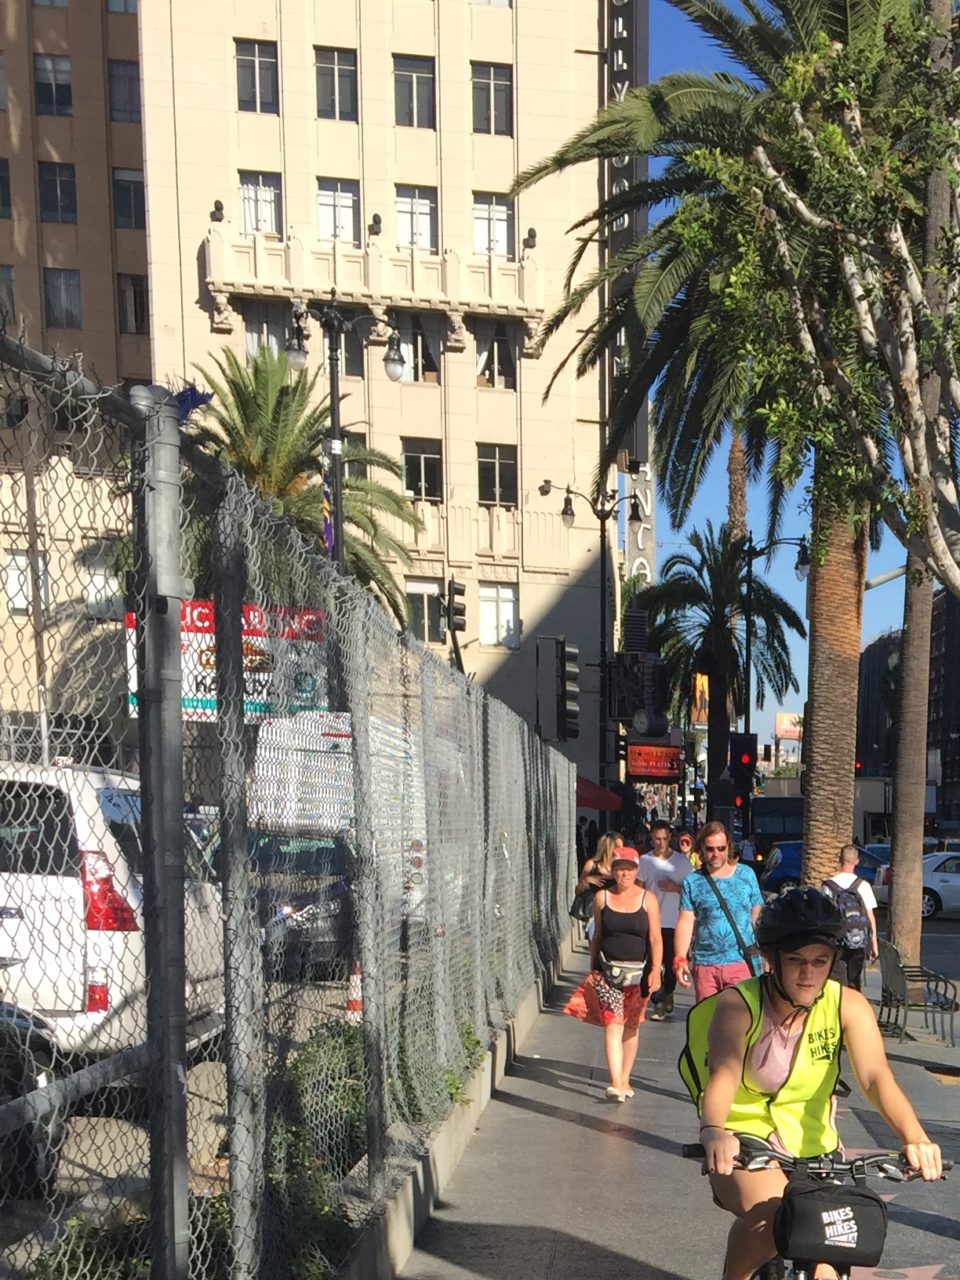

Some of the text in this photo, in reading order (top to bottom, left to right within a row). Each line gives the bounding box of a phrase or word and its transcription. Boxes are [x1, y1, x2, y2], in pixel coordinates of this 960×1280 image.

[808, 1027, 836, 1044] BIKES
[810, 1041, 839, 1059] HIKES
[821, 1206, 854, 1225] BIKES
[825, 1220, 859, 1239] HIKES
